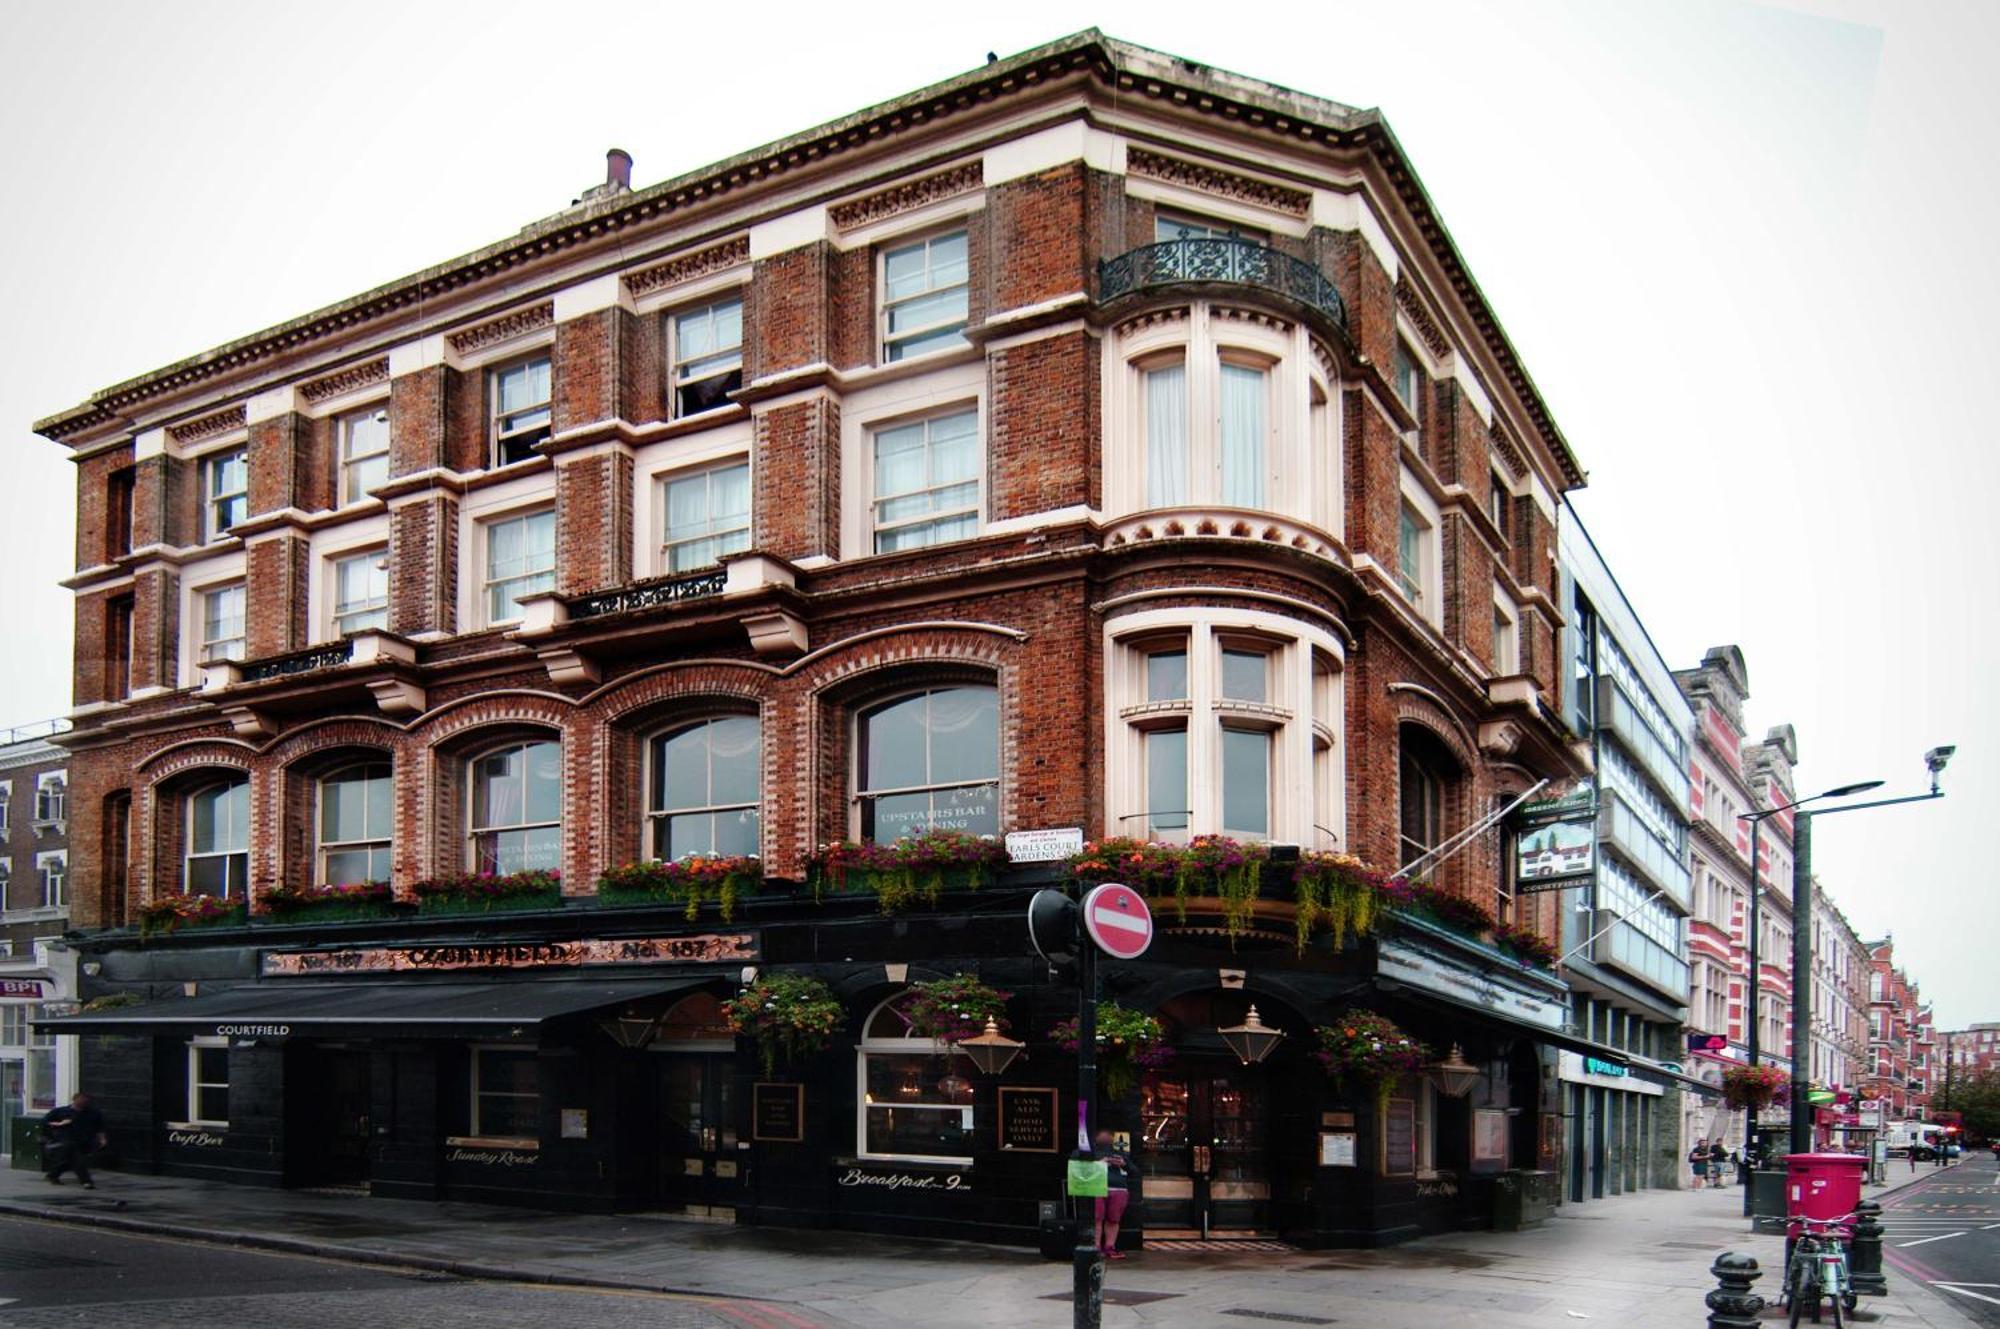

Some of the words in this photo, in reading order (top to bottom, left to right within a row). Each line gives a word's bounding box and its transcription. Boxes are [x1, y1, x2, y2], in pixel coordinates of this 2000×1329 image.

[955, 805, 987, 817] BAR
[1043, 840, 1078, 851] COURT
[1013, 851, 1056, 862] ARDENS
[1522, 878, 1590, 893] COURTFIELD
[408, 943, 567, 965] COURTFIELD
[216, 1024, 290, 1036] COURTFIELD
[168, 1130, 199, 1147] Craft
[194, 1132, 224, 1147] Beer
[446, 1148, 498, 1166] Sunday
[497, 1151, 540, 1167] Roast
[838, 1168, 937, 1190] Breakfast
